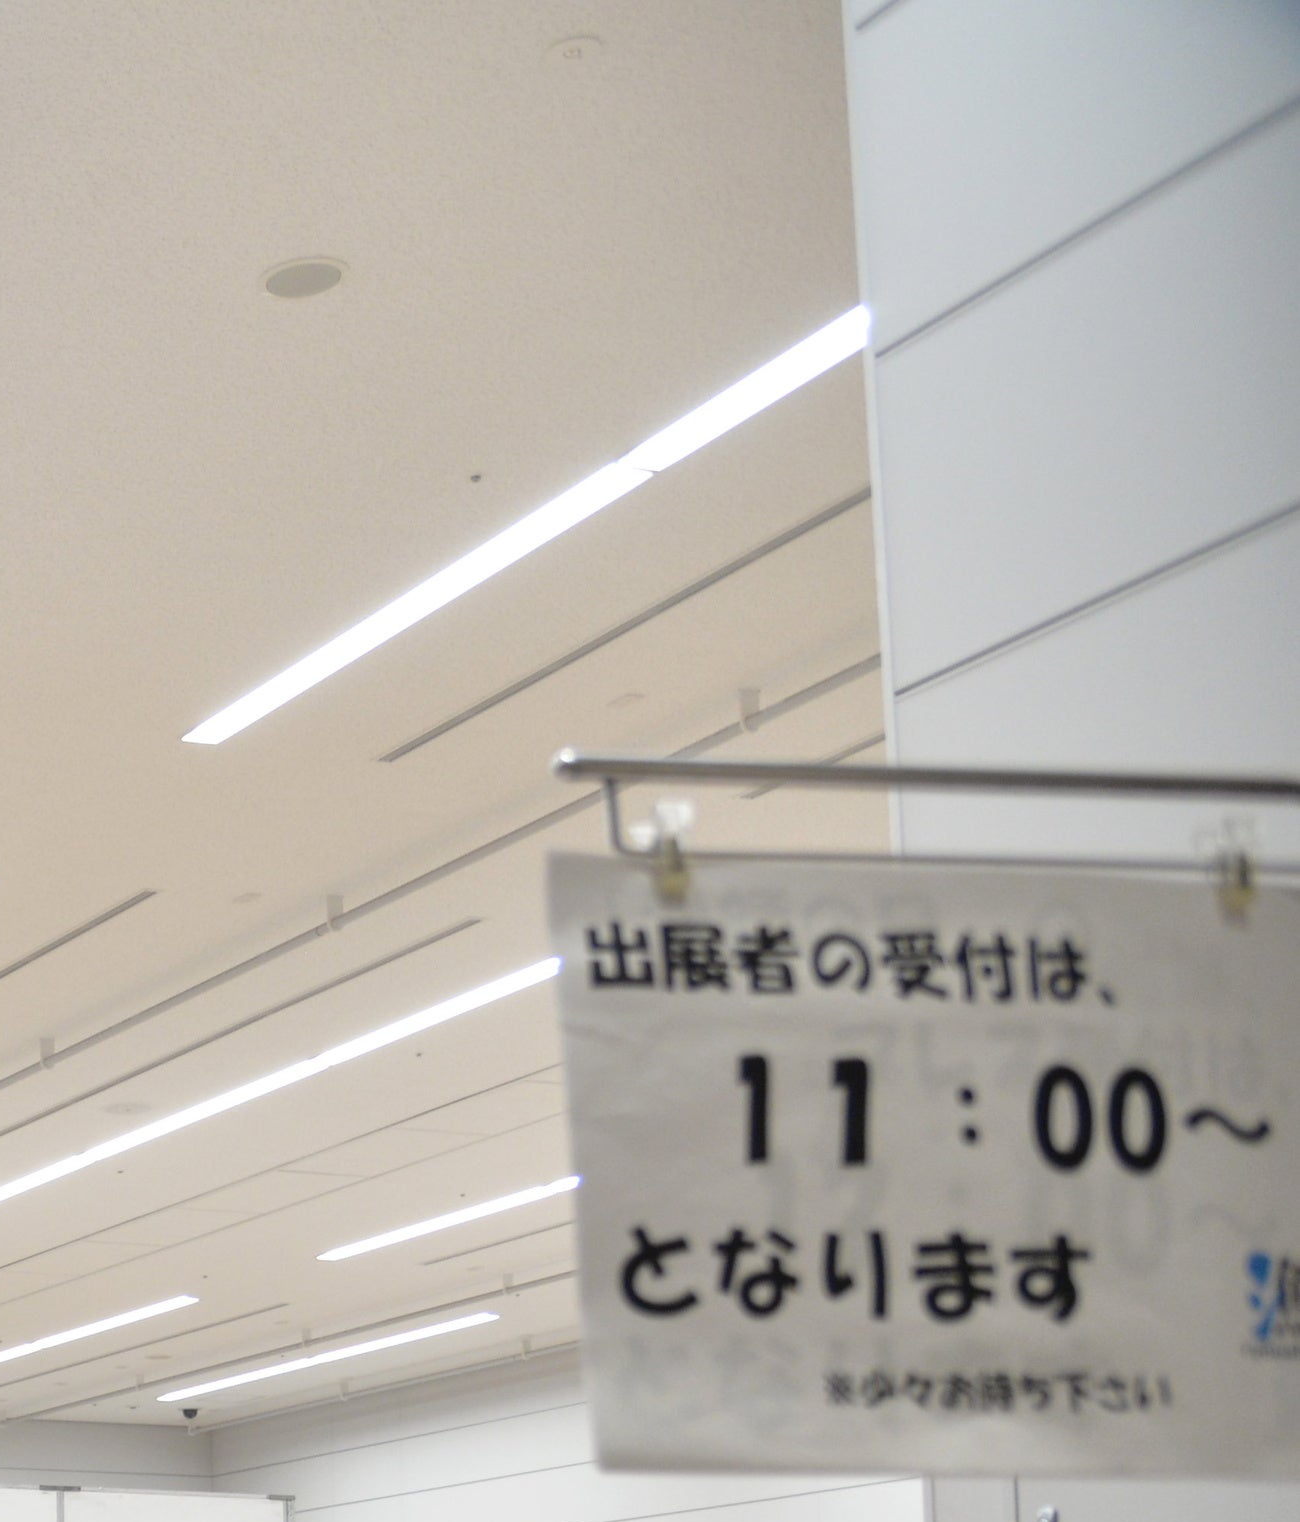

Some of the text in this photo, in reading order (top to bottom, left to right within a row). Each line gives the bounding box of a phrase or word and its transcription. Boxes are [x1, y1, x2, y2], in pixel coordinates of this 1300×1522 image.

[584, 920, 1119, 1006] 出展者の受付は、
[619, 1225, 1090, 1322] となります
